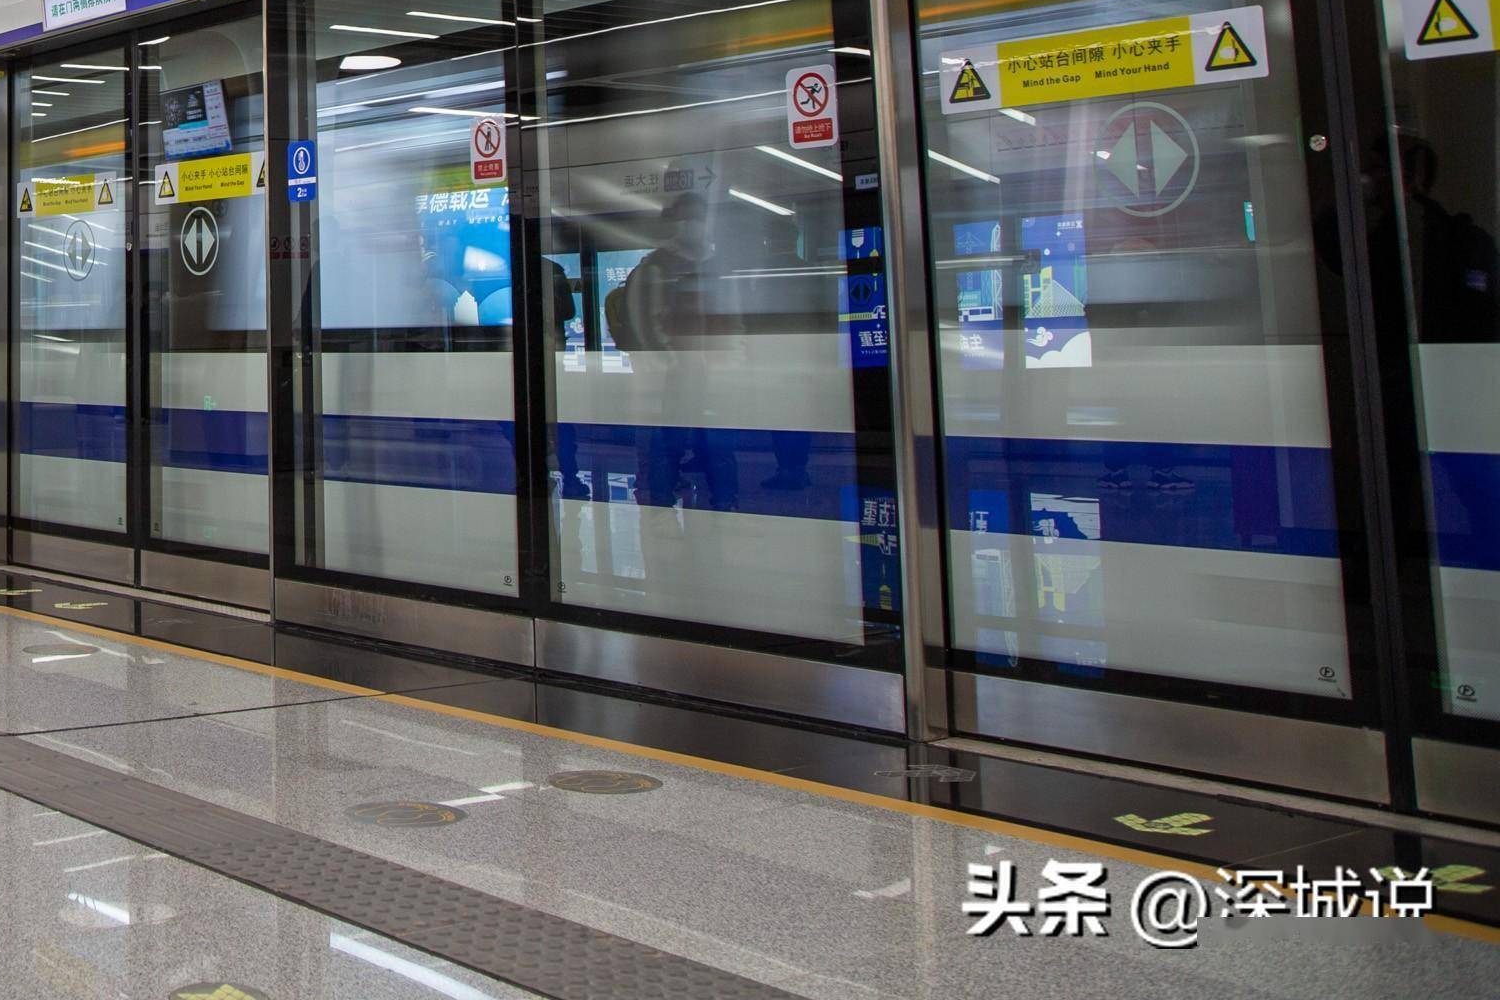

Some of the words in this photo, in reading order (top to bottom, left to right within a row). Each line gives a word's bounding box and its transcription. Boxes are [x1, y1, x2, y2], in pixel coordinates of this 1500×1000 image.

[1007, 46, 1105, 74] 小心站台间隙
[1111, 35, 1182, 58] 小心夹手
[1022, 77, 1045, 88] Mind
[1046, 76, 1061, 86] the
[1062, 74, 1082, 85] Gap
[1094, 68, 1118, 79] Mind
[1120, 65, 1142, 76] Your
[1144, 62, 1169, 73] Hand
[182, 168, 206, 182] 小心夹手
[209, 164, 248, 179] 小心站台间隙
